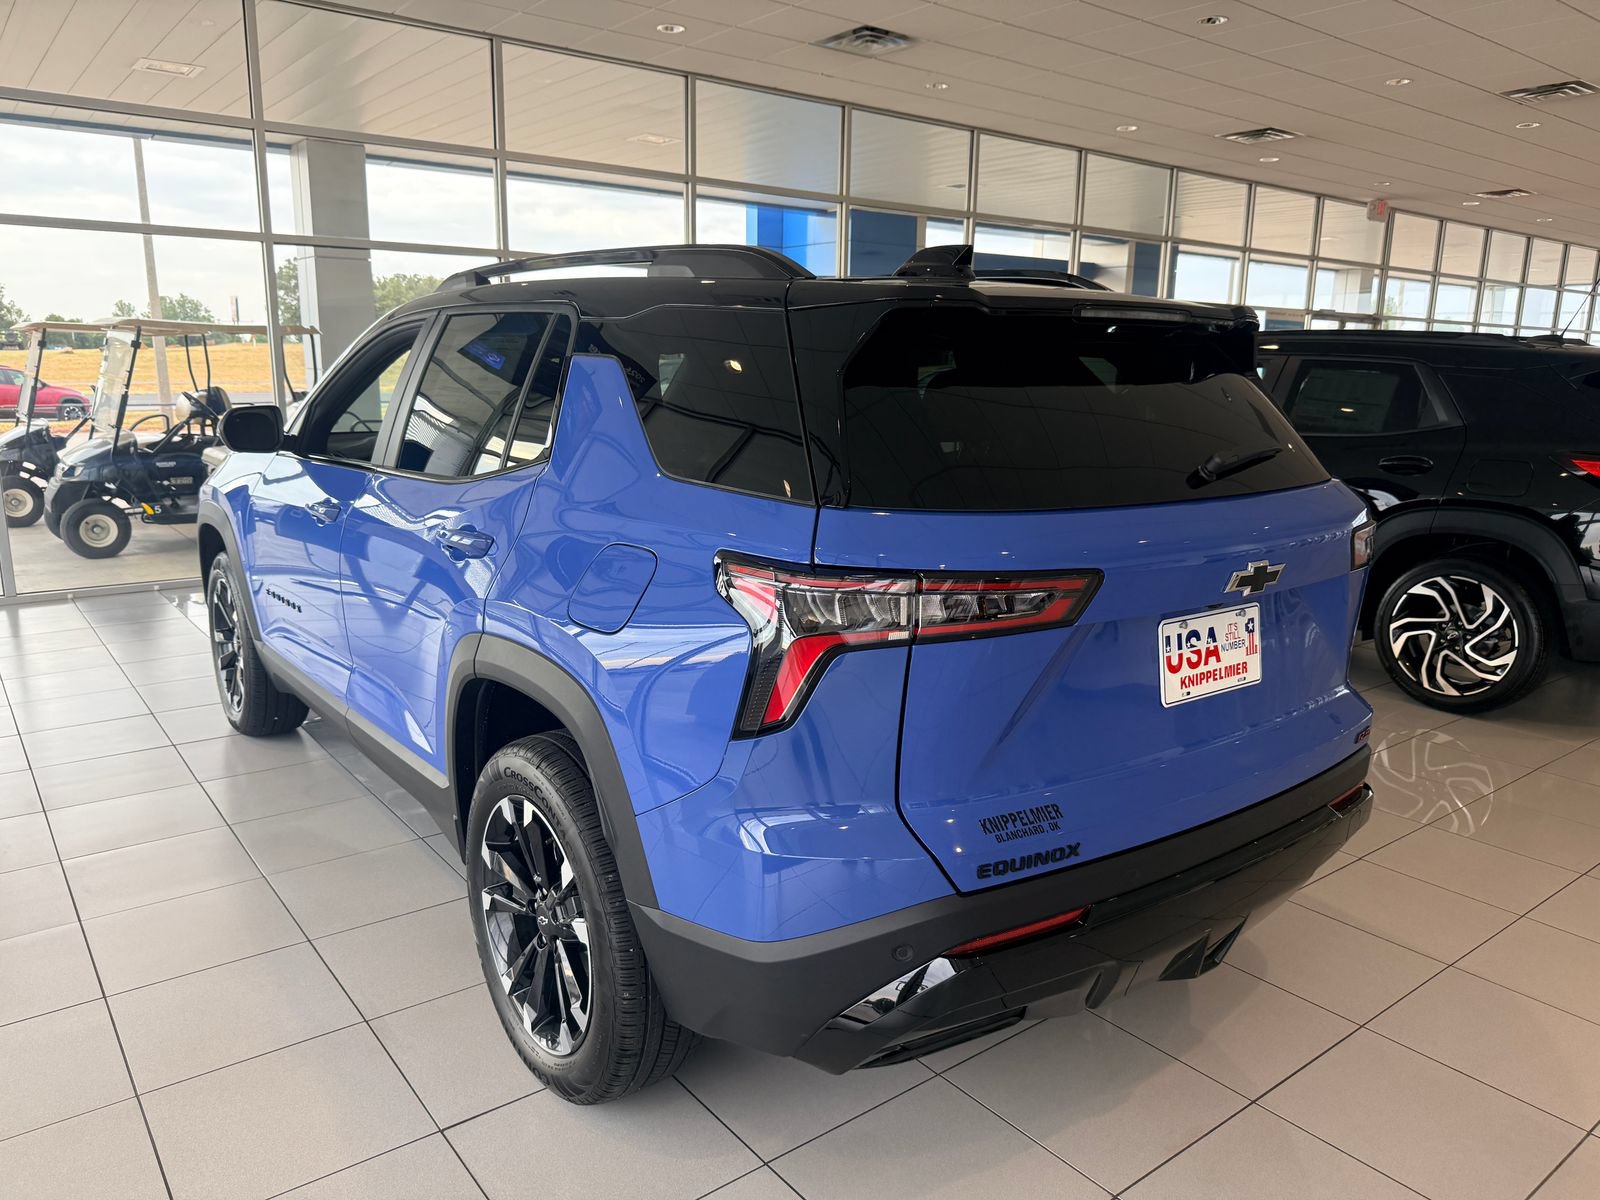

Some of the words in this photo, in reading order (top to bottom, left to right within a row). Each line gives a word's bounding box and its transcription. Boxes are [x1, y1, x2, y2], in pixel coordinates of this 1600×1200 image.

[1225, 631, 1241, 642] STILL
[1227, 622, 1238, 633] IT'S
[1165, 626, 1221, 675] USA
[1221, 638, 1246, 653] NUMBER
[1180, 661, 1248, 690] KNIPPELMIER
[978, 803, 1064, 836] KNIPPELMIER
[995, 824, 1049, 844] BLANCHARD,
[1050, 821, 1062, 832] OK
[976, 842, 1081, 880] EQUINOX
